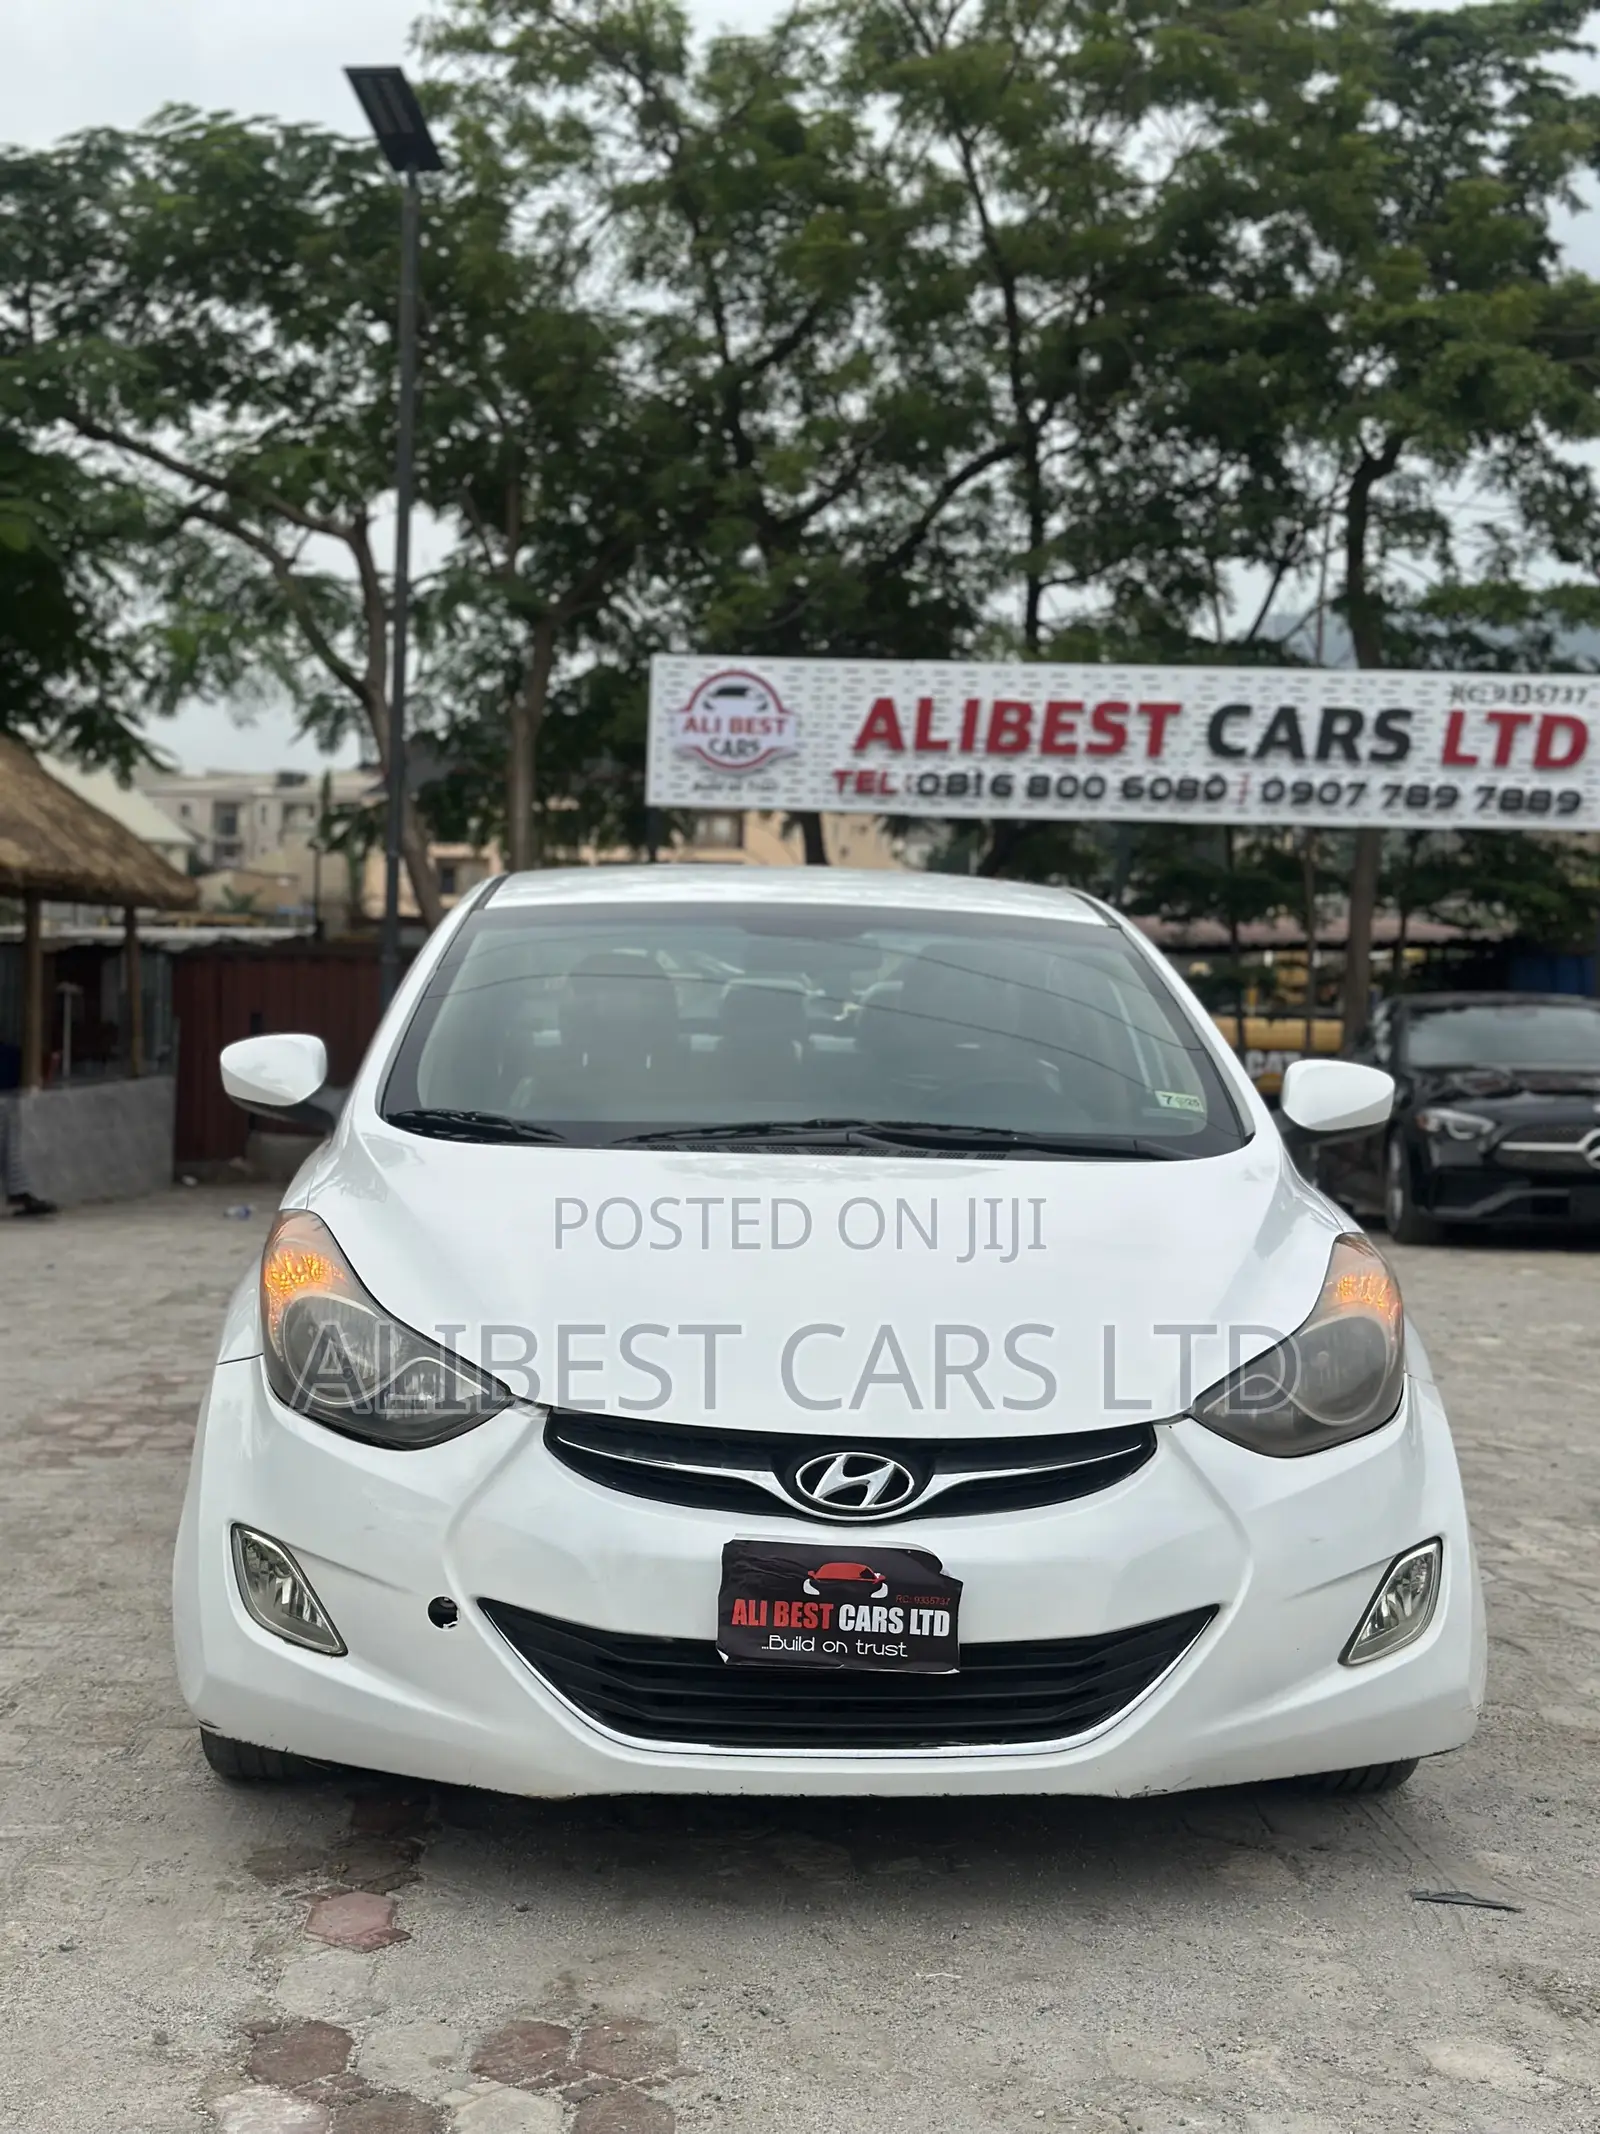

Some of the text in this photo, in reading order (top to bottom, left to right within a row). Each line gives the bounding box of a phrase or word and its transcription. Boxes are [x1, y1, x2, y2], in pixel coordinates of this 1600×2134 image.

[683, 716, 787, 737] ALI BEST
[853, 697, 1589, 768] ALIBEST CARS LTD
[708, 737, 760, 758] CARS
[1026, 774, 1107, 800] 800
[1261, 779, 1367, 808] 0907
[1381, 781, 1459, 809] 789
[731, 1598, 950, 1637] ALI BEST CARS LTD
[822, 1640, 848, 1654] on
[855, 1638, 908, 1658] trust
